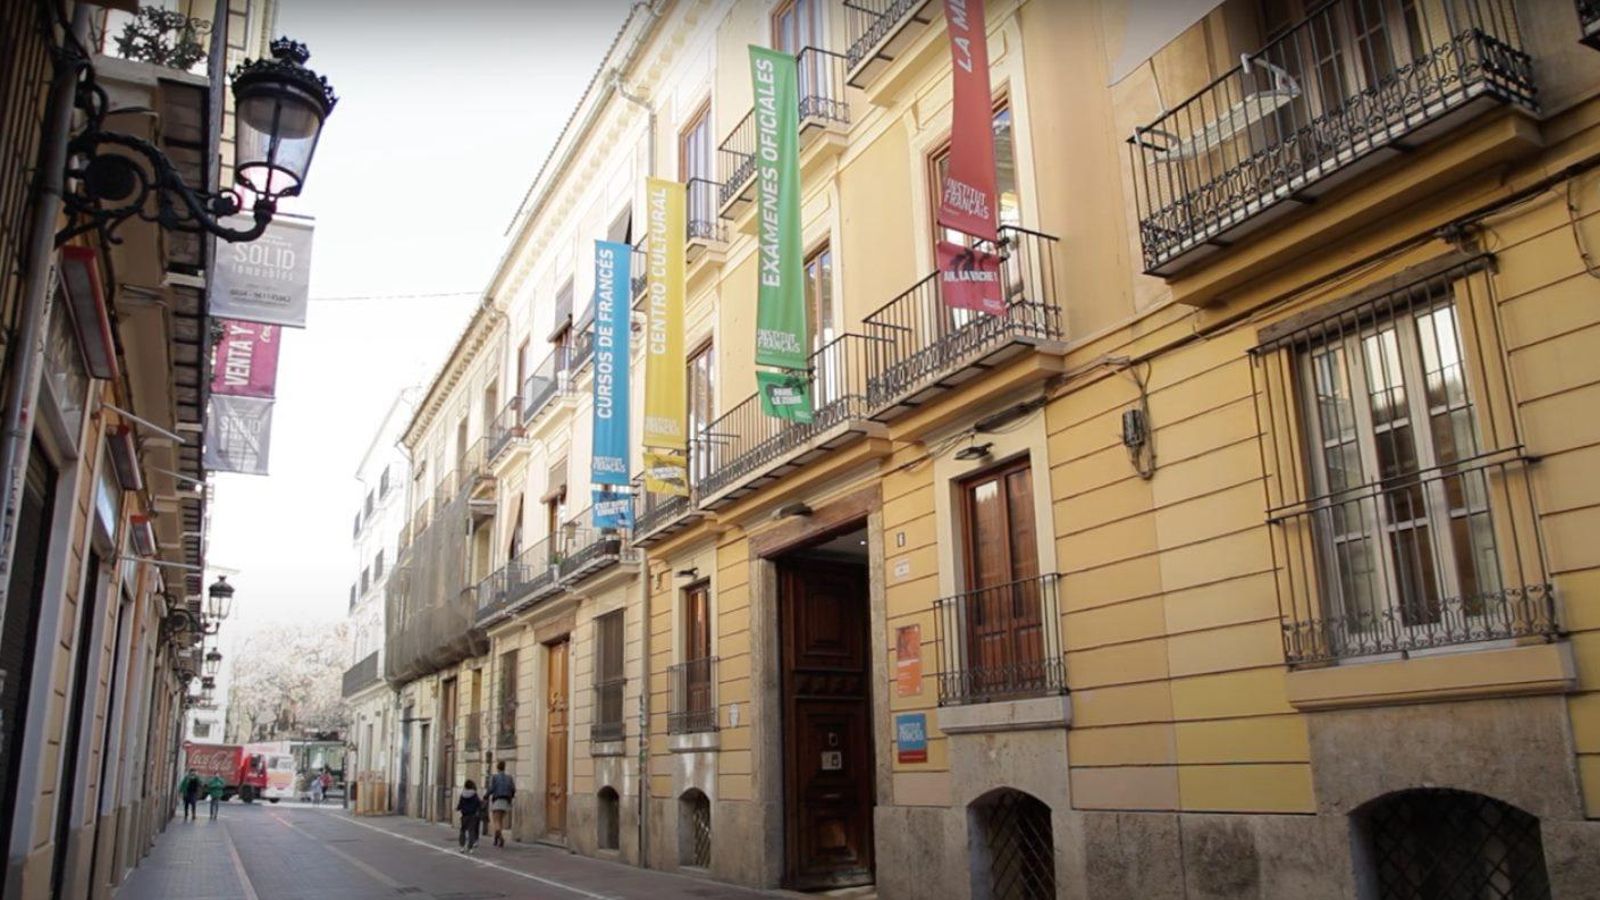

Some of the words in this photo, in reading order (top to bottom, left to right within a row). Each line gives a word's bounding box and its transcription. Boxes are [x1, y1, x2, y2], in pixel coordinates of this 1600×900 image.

[953, 36, 973, 73] LA
[756, 58, 779, 163] OFICIALES
[233, 242, 296, 271] SOLID
[651, 188, 668, 276] CULTURAL
[758, 167, 781, 287] EXÁMENES
[596, 248, 614, 322] FRANCÉS
[650, 283, 667, 355] CENTRO
[224, 341, 253, 386] VENTA
[598, 326, 614, 348] DE
[597, 352, 614, 419] CURSOS
